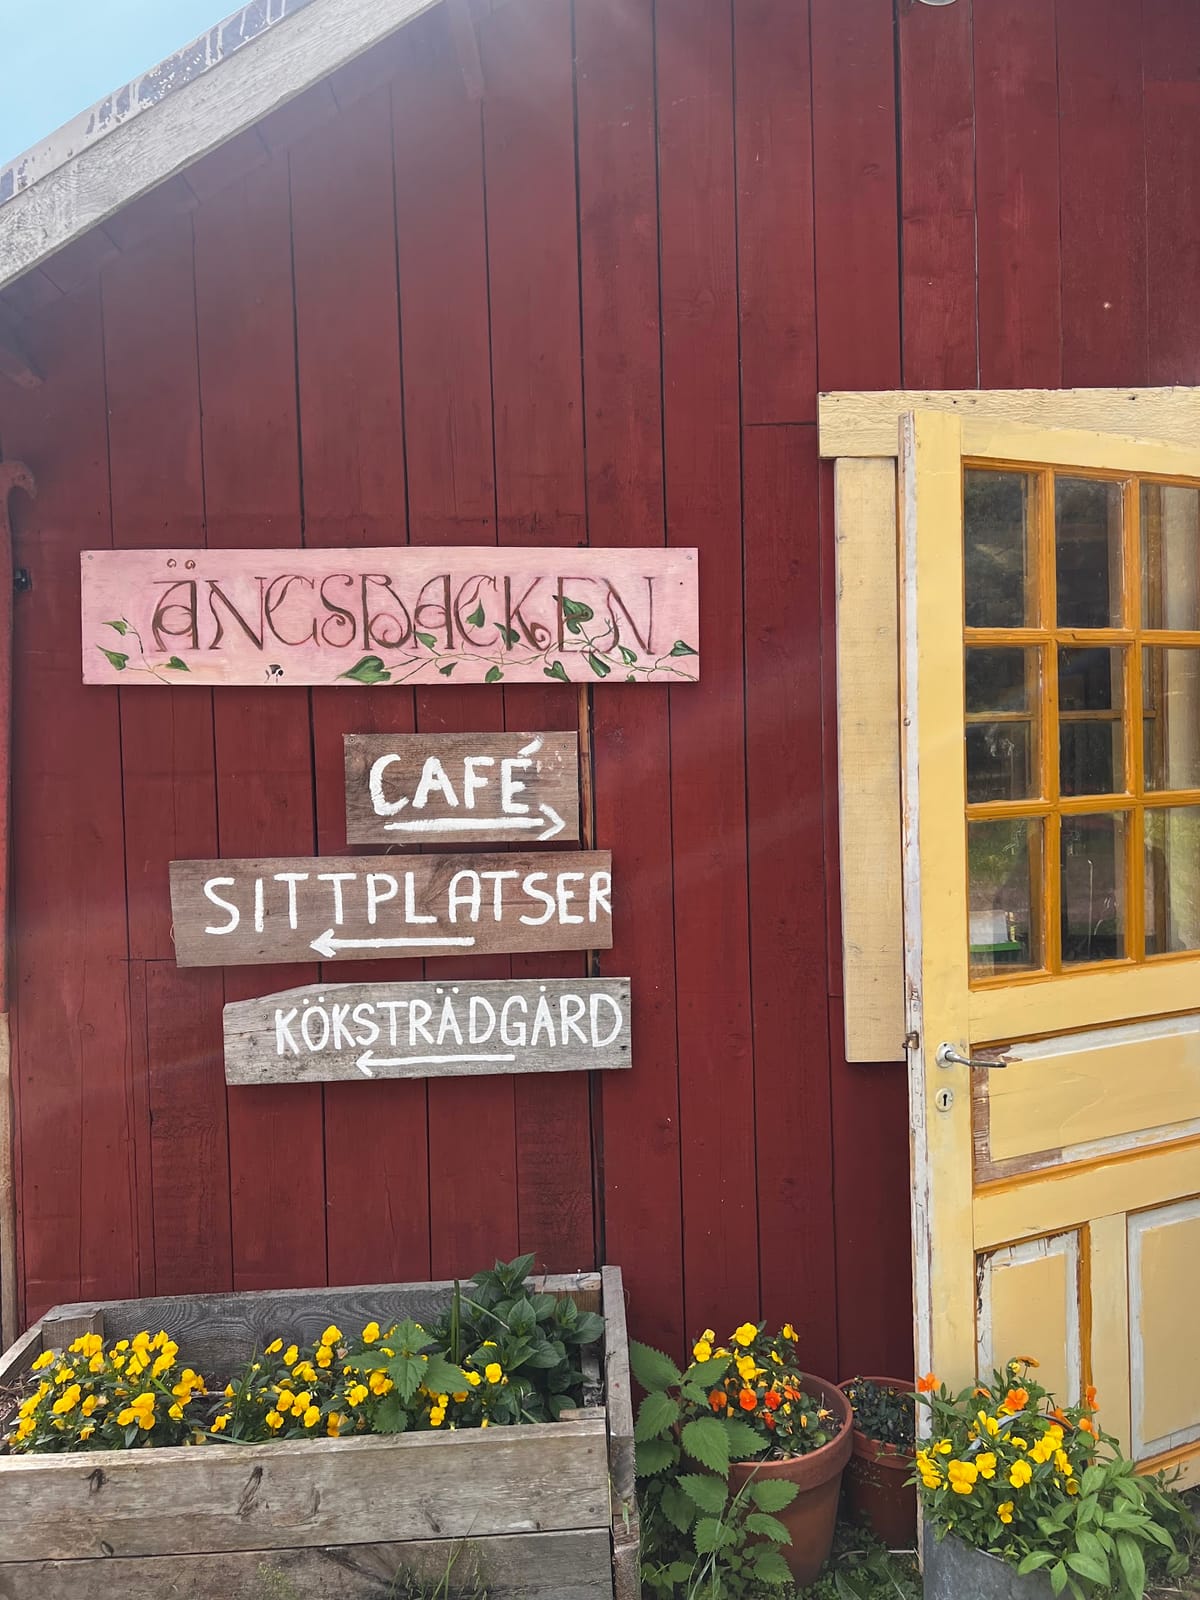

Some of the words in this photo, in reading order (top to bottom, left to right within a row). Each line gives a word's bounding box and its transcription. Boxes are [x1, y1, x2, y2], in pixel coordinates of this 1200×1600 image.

[368, 735, 543, 815] CAFÉ
[203, 870, 612, 935] SITTPLATSER
[274, 986, 624, 1056] KÖKSTRÄDGÅRD
